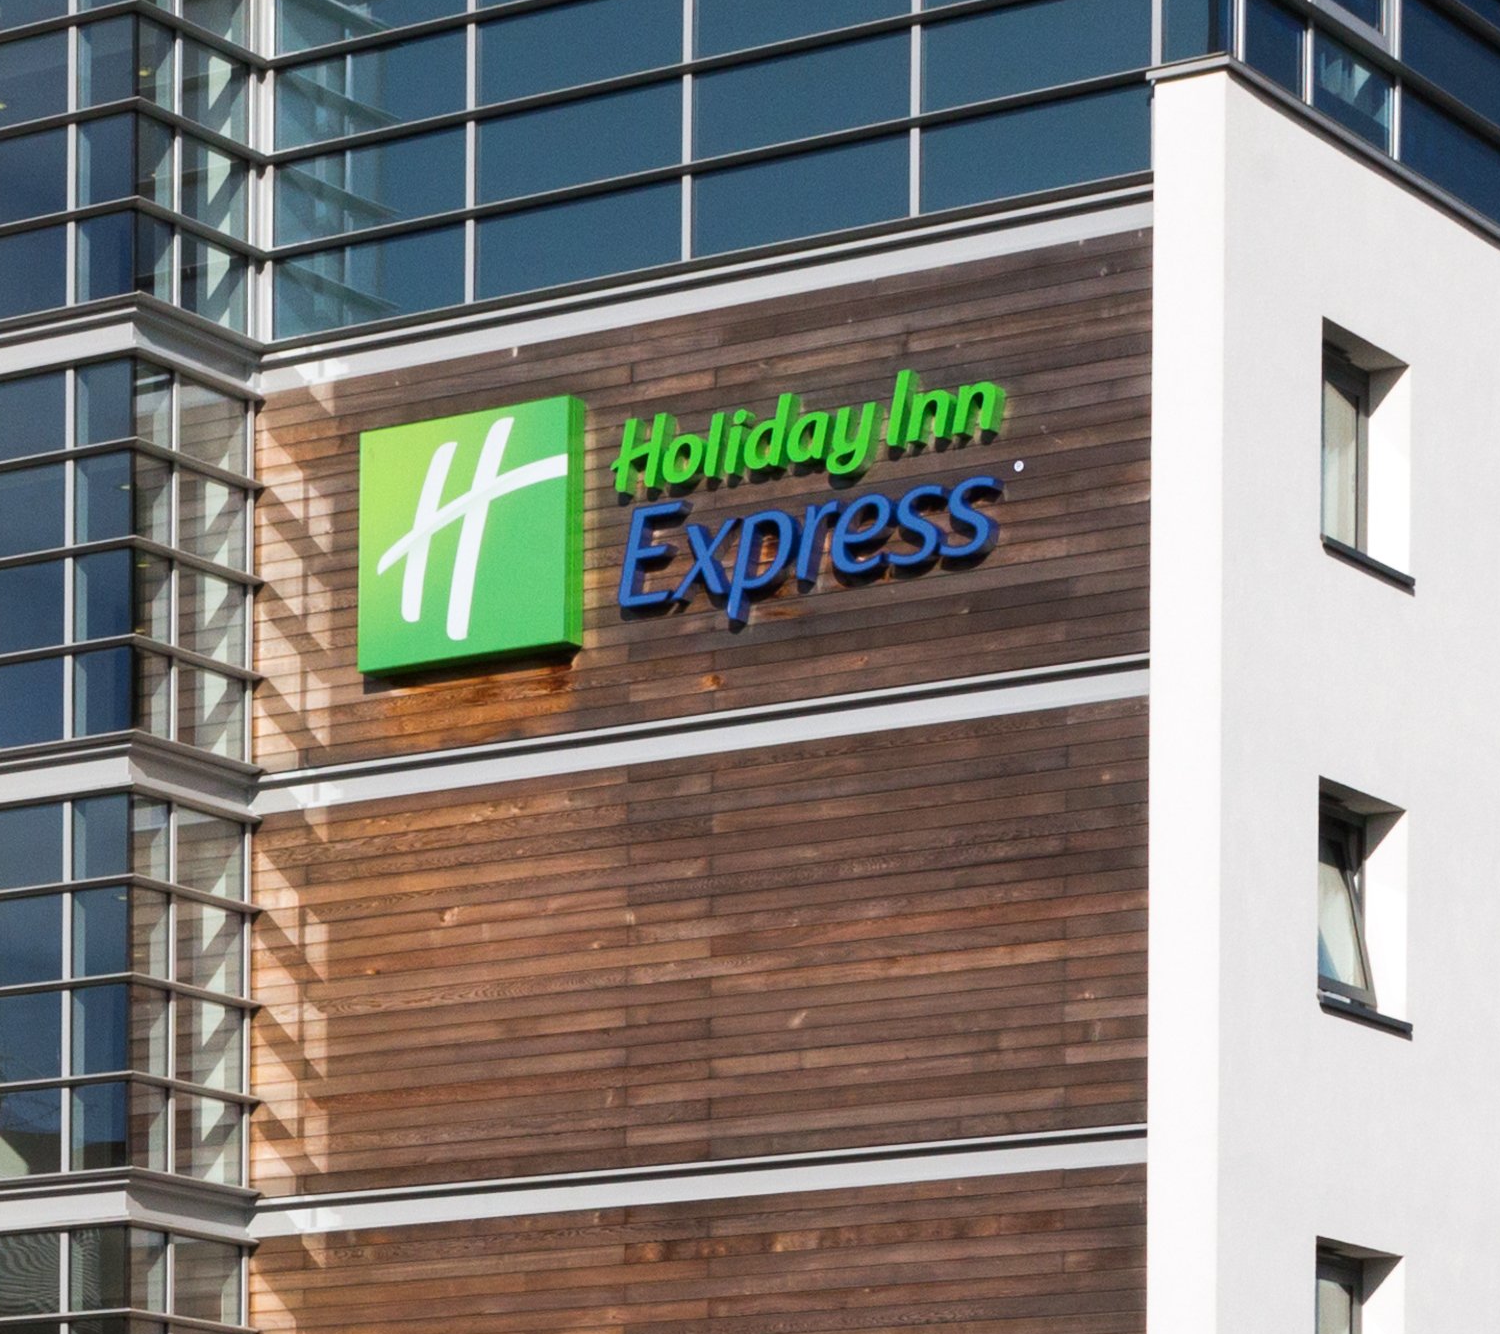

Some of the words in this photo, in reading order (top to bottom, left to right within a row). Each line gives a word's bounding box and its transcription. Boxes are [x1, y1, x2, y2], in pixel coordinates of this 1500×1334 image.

[612, 392, 883, 495] Holiday
[887, 369, 1006, 449] Inn
[617, 475, 1003, 624] Express
